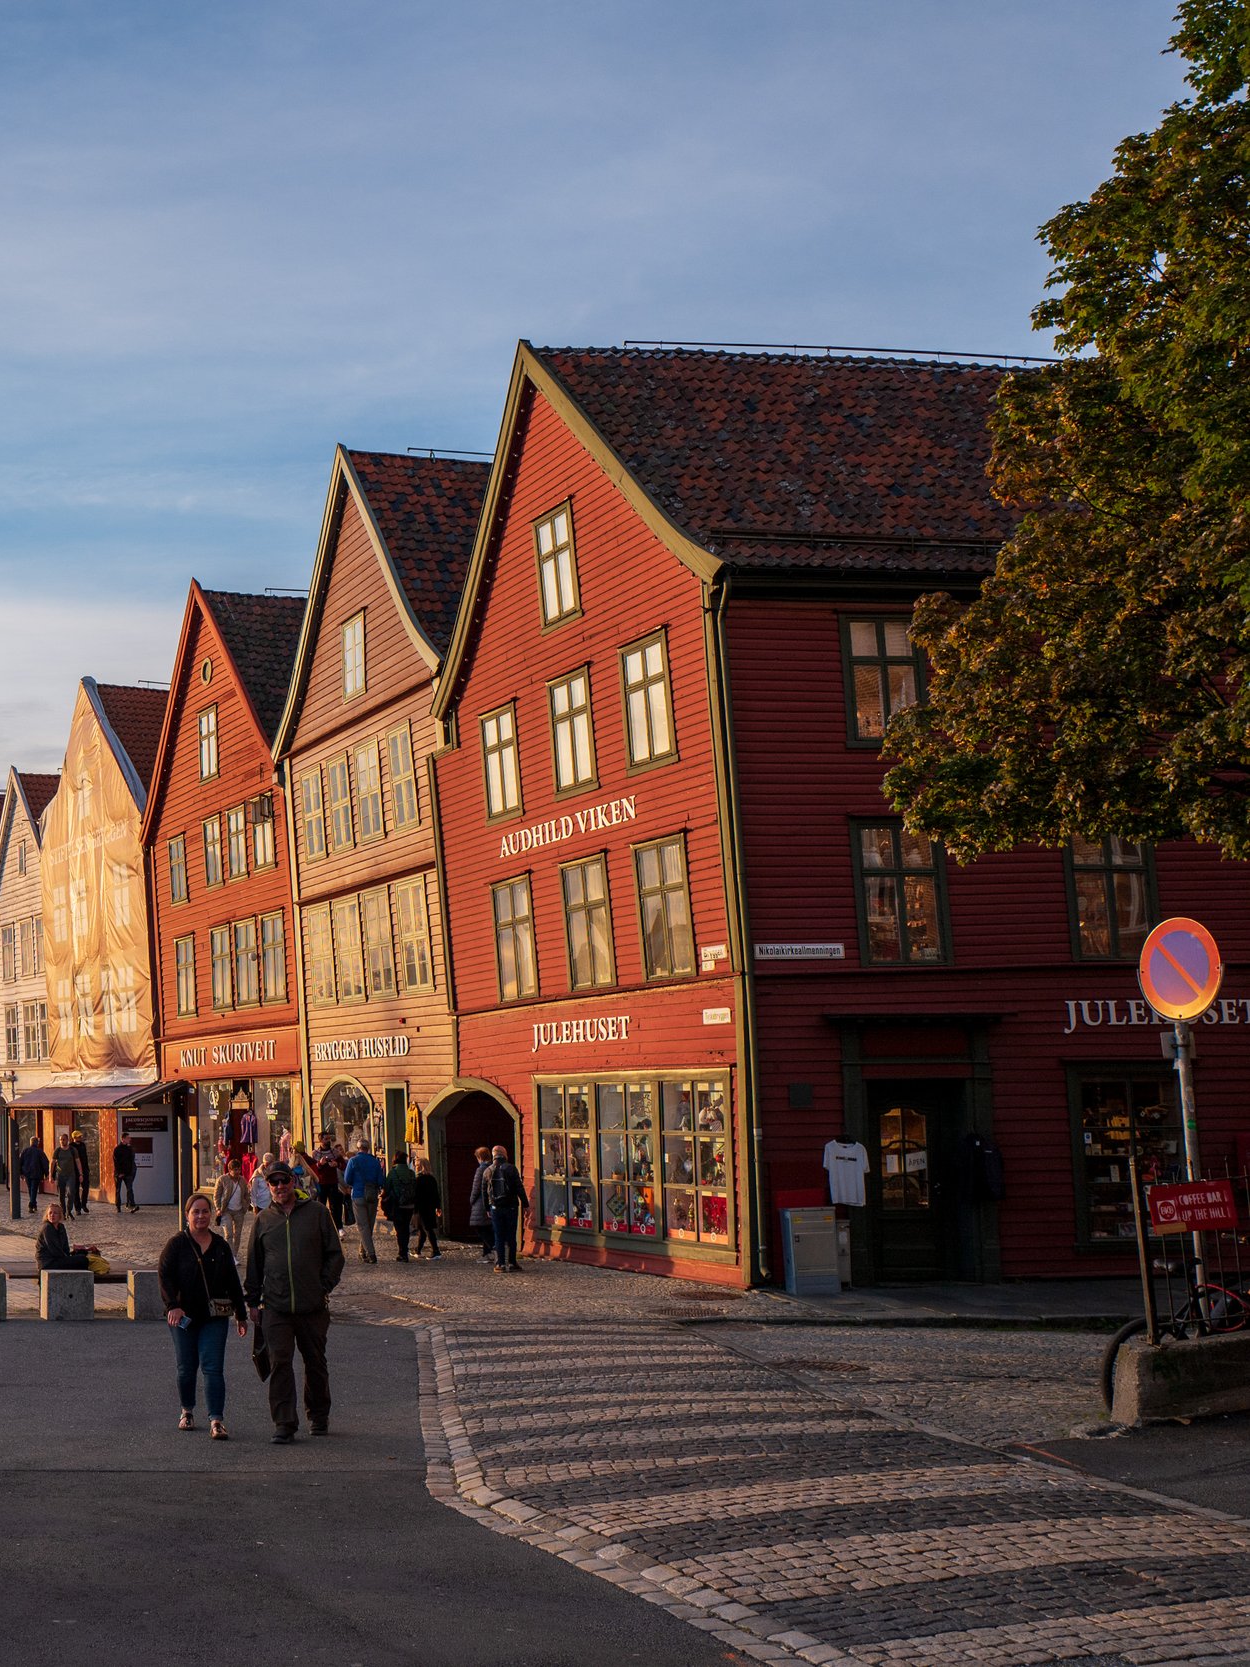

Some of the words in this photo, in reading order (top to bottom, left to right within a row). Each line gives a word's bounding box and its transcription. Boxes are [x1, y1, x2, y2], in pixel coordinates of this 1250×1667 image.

[499, 815, 574, 858] AUDHILD
[575, 795, 637, 834] VIKEN
[758, 945, 841, 957] Nikolaikirkeallmenningen
[1063, 999, 1250, 1034] JULESET
[531, 1015, 631, 1053] JULEHUSET
[180, 1047, 207, 1068] KNUT
[212, 1039, 276, 1065] SKURTVEIT
[314, 1039, 361, 1062] BRYGGEN
[362, 1035, 409, 1059] HUSFLID
[1178, 1192, 1206, 1206] COFFEE
[1206, 1190, 1222, 1203] BAR
[1181, 1209, 1193, 1222] UP
[1194, 1207, 1209, 1220] THE
[1209, 1206, 1227, 1219] HILL
